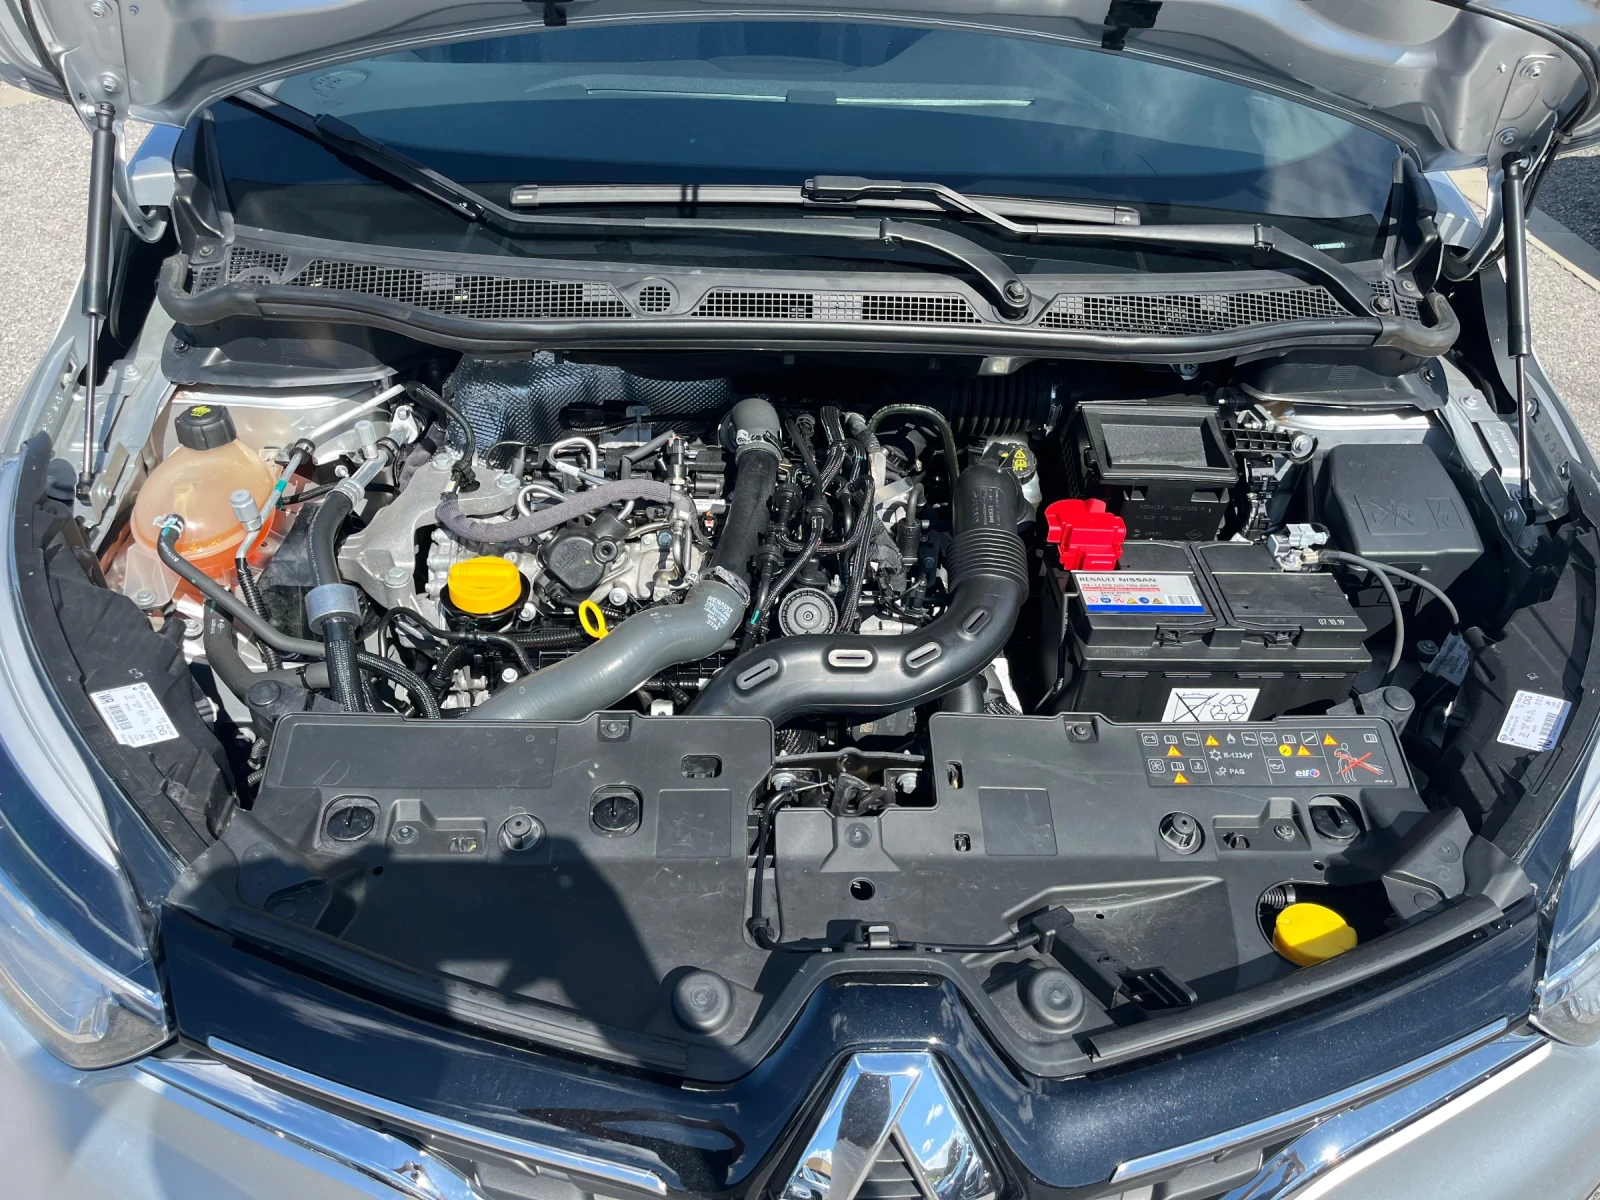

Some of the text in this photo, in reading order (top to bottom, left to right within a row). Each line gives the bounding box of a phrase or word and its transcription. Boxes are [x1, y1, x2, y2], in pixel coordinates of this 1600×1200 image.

[707, 596, 733, 613] RENAULT
[155, 724, 168, 737] DG
[1295, 769, 1310, 777] elf
